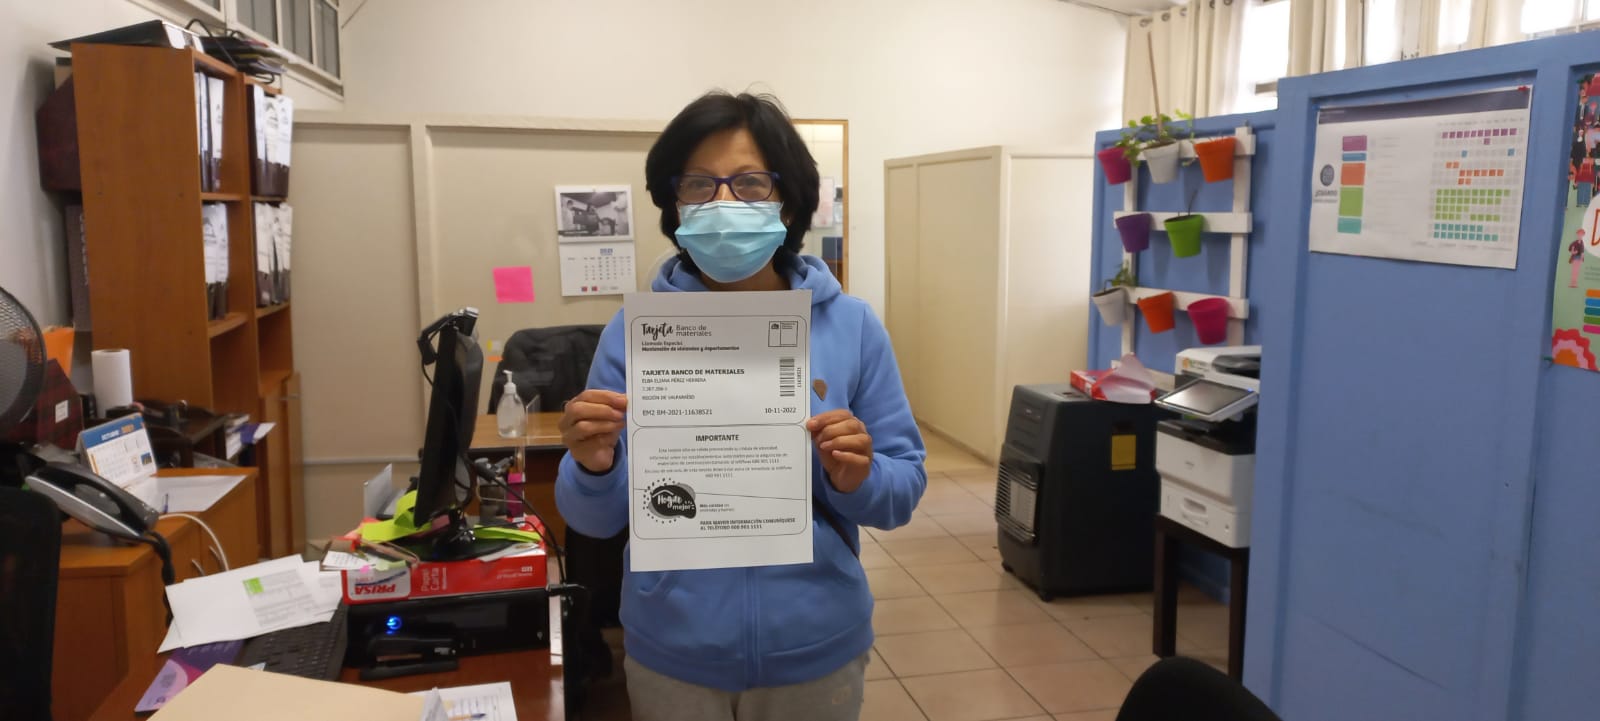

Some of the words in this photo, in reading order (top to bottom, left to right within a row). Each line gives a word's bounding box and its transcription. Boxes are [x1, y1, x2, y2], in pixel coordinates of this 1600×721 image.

[641, 322, 673, 340] Tarjeta
[658, 495, 683, 508] Hogar
[354, 584, 396, 596] PRISA
